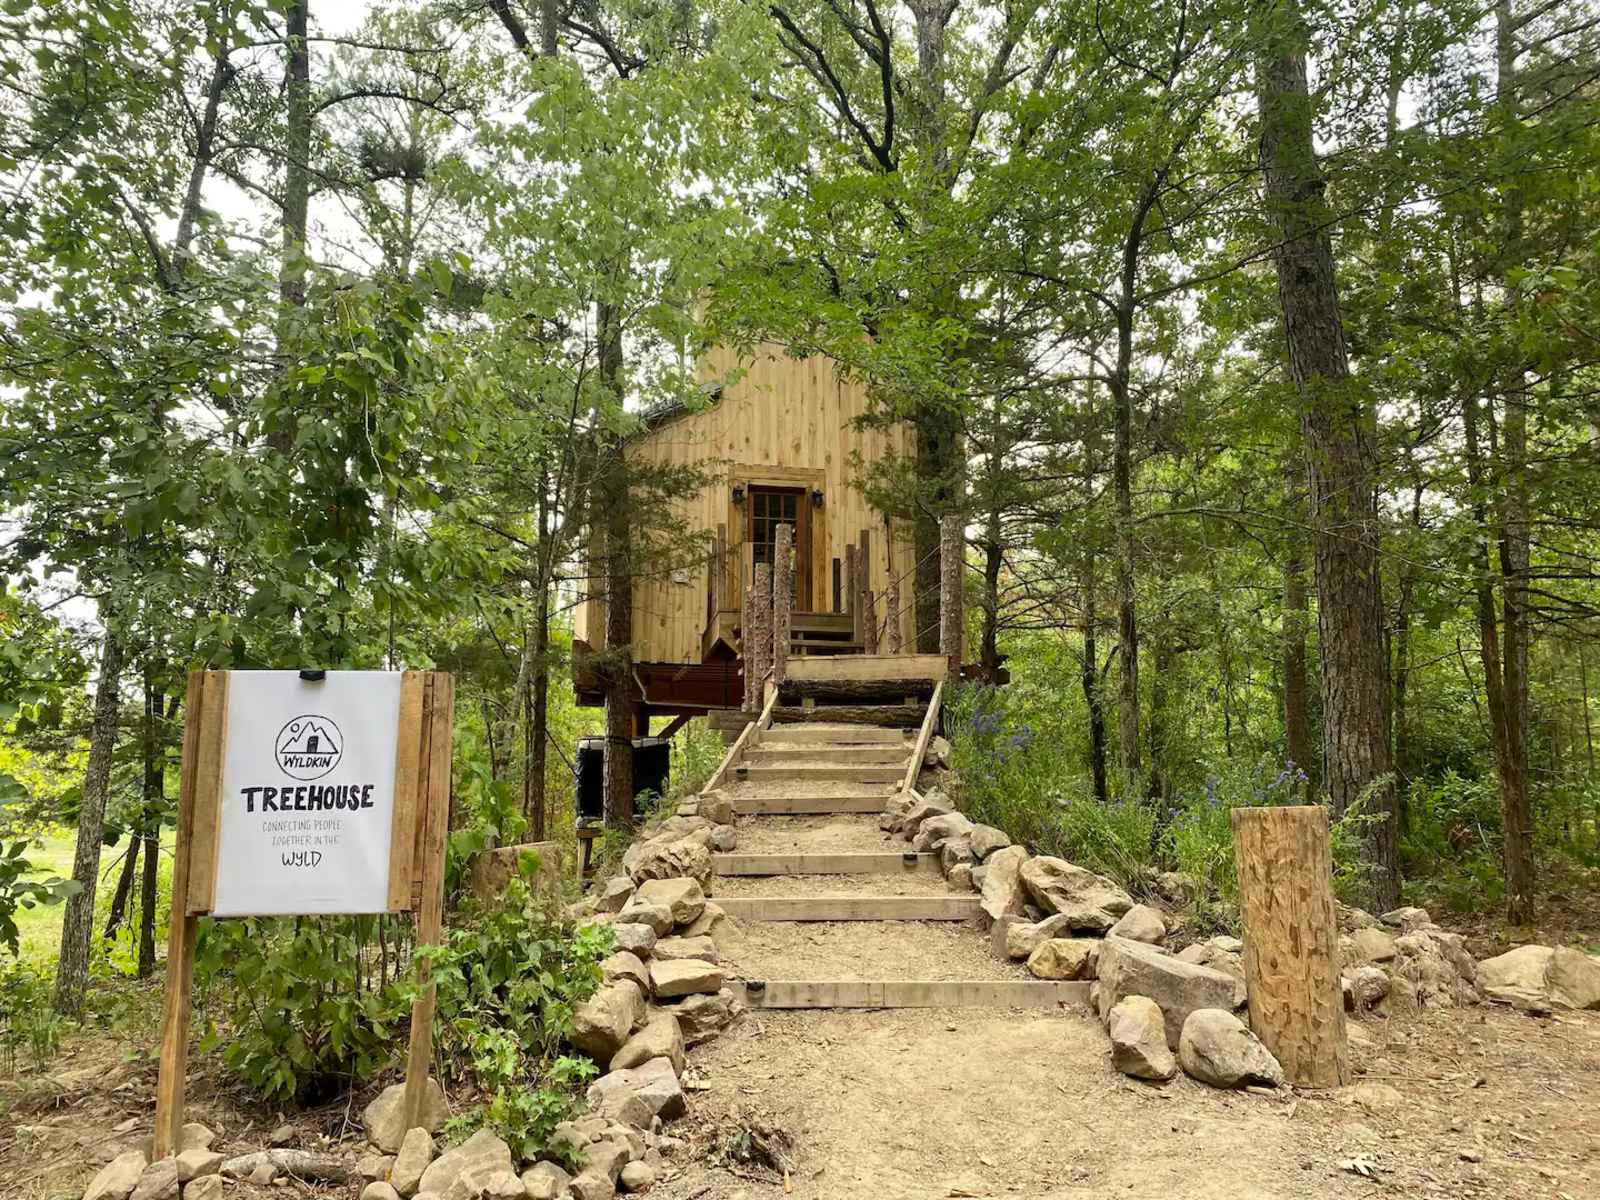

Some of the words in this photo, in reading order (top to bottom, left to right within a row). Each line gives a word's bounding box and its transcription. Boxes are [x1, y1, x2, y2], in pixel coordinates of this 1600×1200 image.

[284, 755, 332, 768] WYLDKIN
[241, 784, 374, 812] TREEHOUSE
[262, 820, 311, 832] CONNECTING
[314, 819, 342, 831] PEOPLE
[272, 835, 312, 846] TOGETHER
